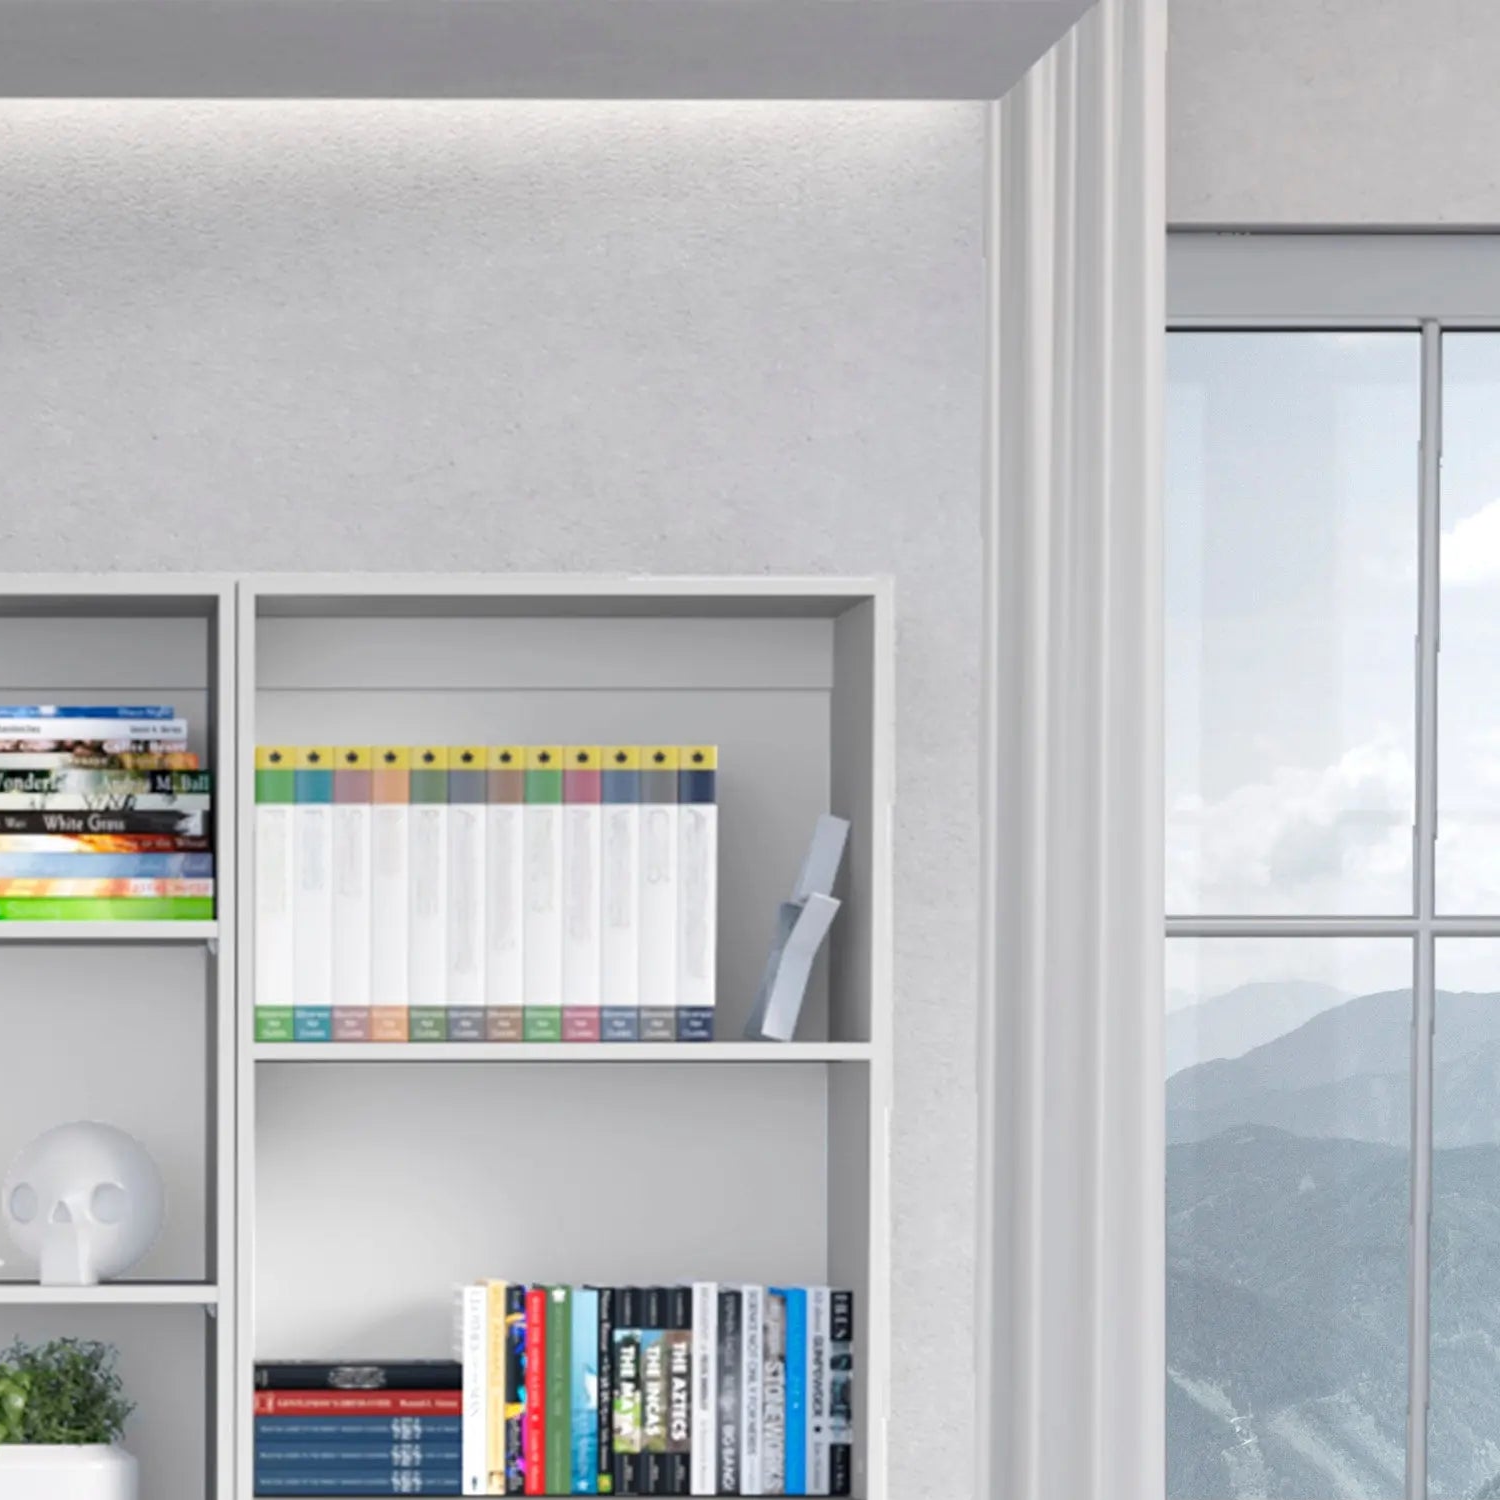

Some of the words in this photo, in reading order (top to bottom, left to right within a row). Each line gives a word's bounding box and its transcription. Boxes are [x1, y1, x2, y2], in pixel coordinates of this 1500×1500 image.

[42, 813, 83, 831] White
[619, 1346, 635, 1376] THE
[645, 1346, 661, 1375] THE
[671, 1342, 687, 1373] THE
[619, 1382, 635, 1435] MAYA
[645, 1381, 661, 1435] INCAS
[671, 1377, 687, 1440] AZTECS
